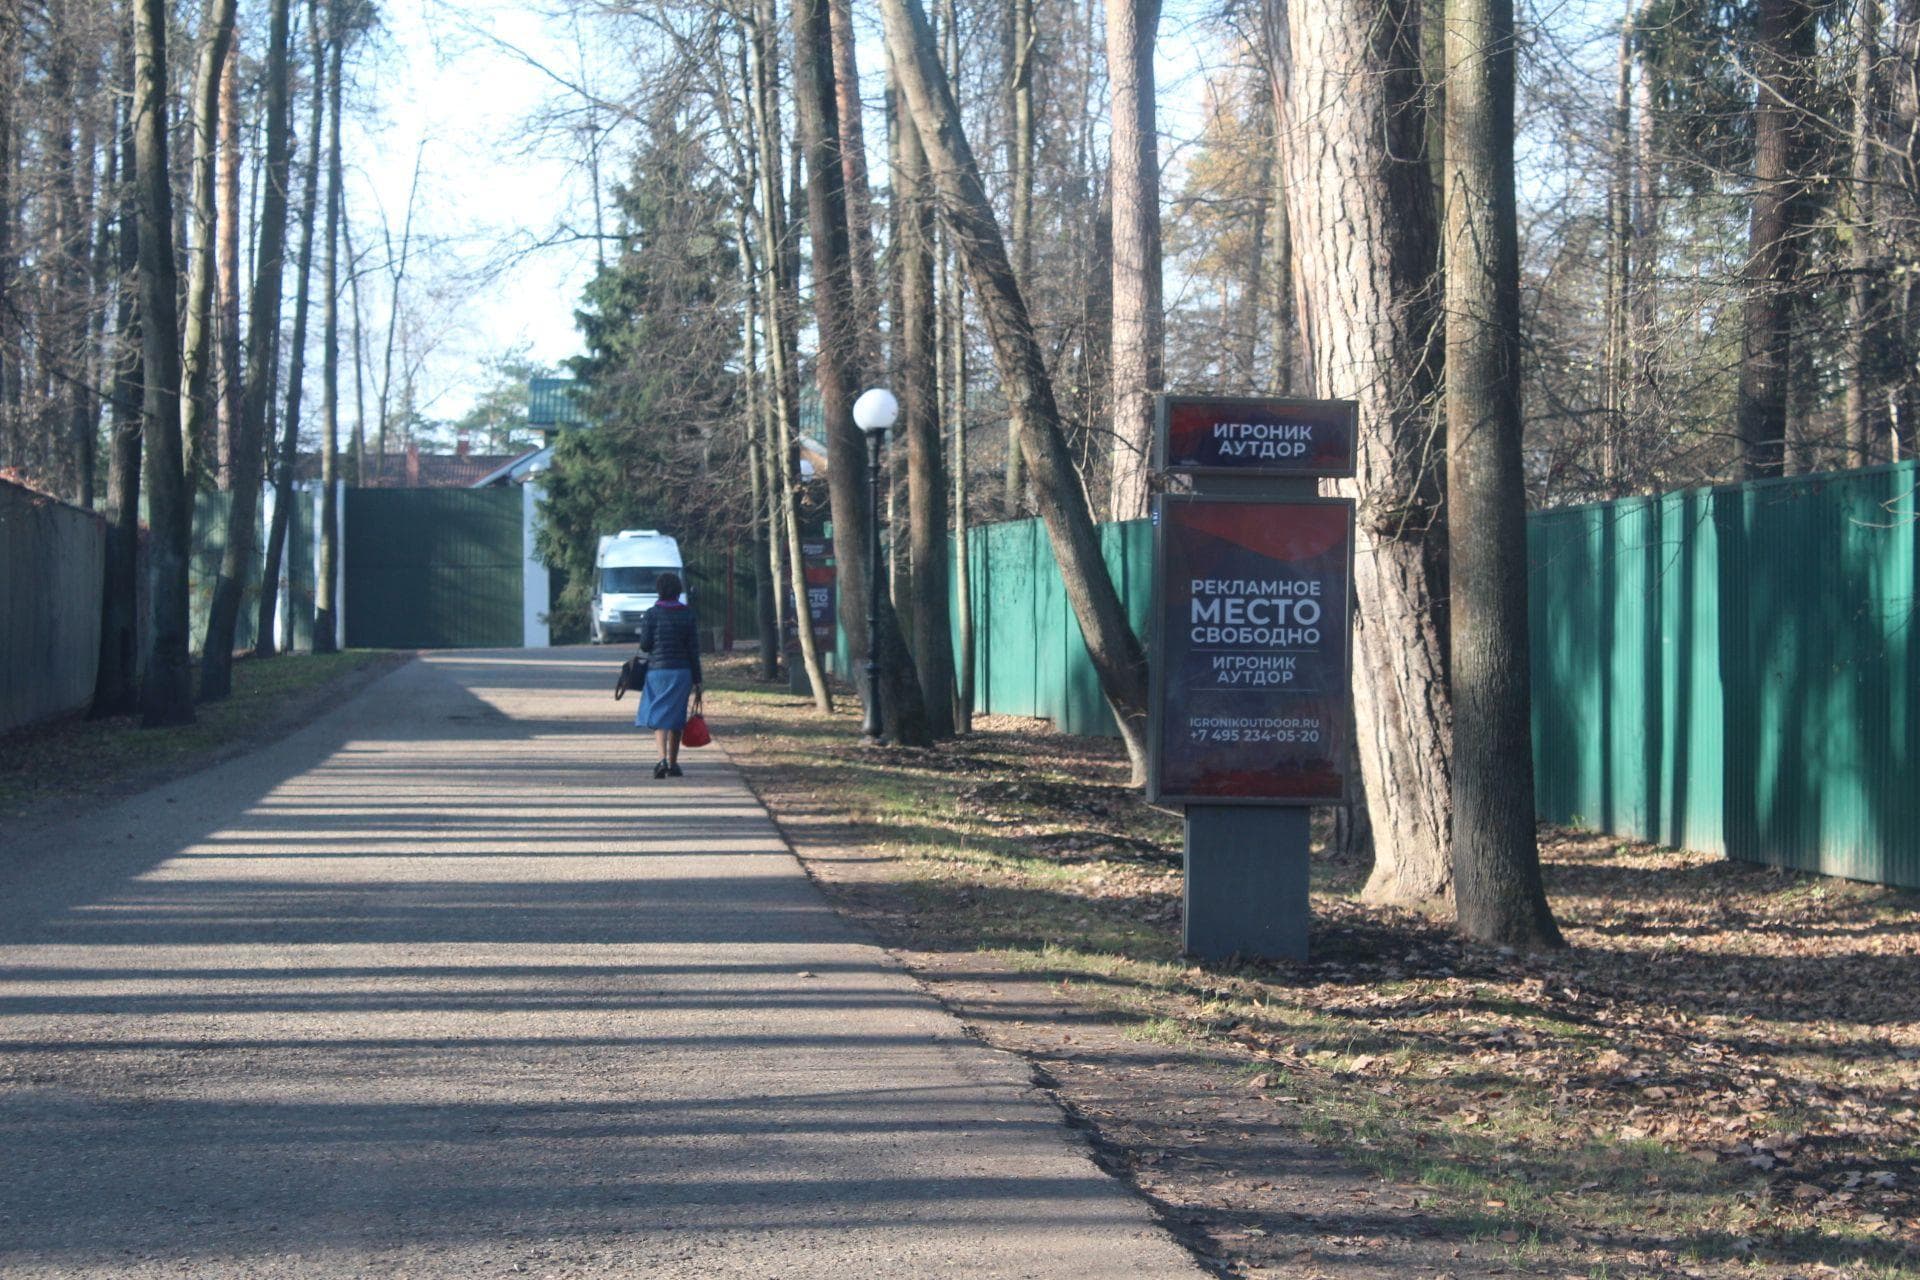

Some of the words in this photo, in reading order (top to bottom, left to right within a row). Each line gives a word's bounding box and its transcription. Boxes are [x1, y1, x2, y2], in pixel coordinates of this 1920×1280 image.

[1214, 423, 1312, 440] ИГРОНИК
[1218, 441, 1306, 459] АУТДОР
[1191, 580, 1321, 596] РЕКЛАМНОЕ
[1191, 598, 1321, 625] МЕСТО
[1191, 627, 1320, 646] СВОБОДНО
[1213, 656, 1296, 670] ИГРОНИК
[1217, 671, 1293, 685] АУТДОР
[1190, 717, 1320, 728] IGRONIKOUTDOOR.RU
[1190, 730, 1208, 741] +7
[1211, 730, 1239, 741] 495
[1243, 730, 1320, 742] 234-05-20
